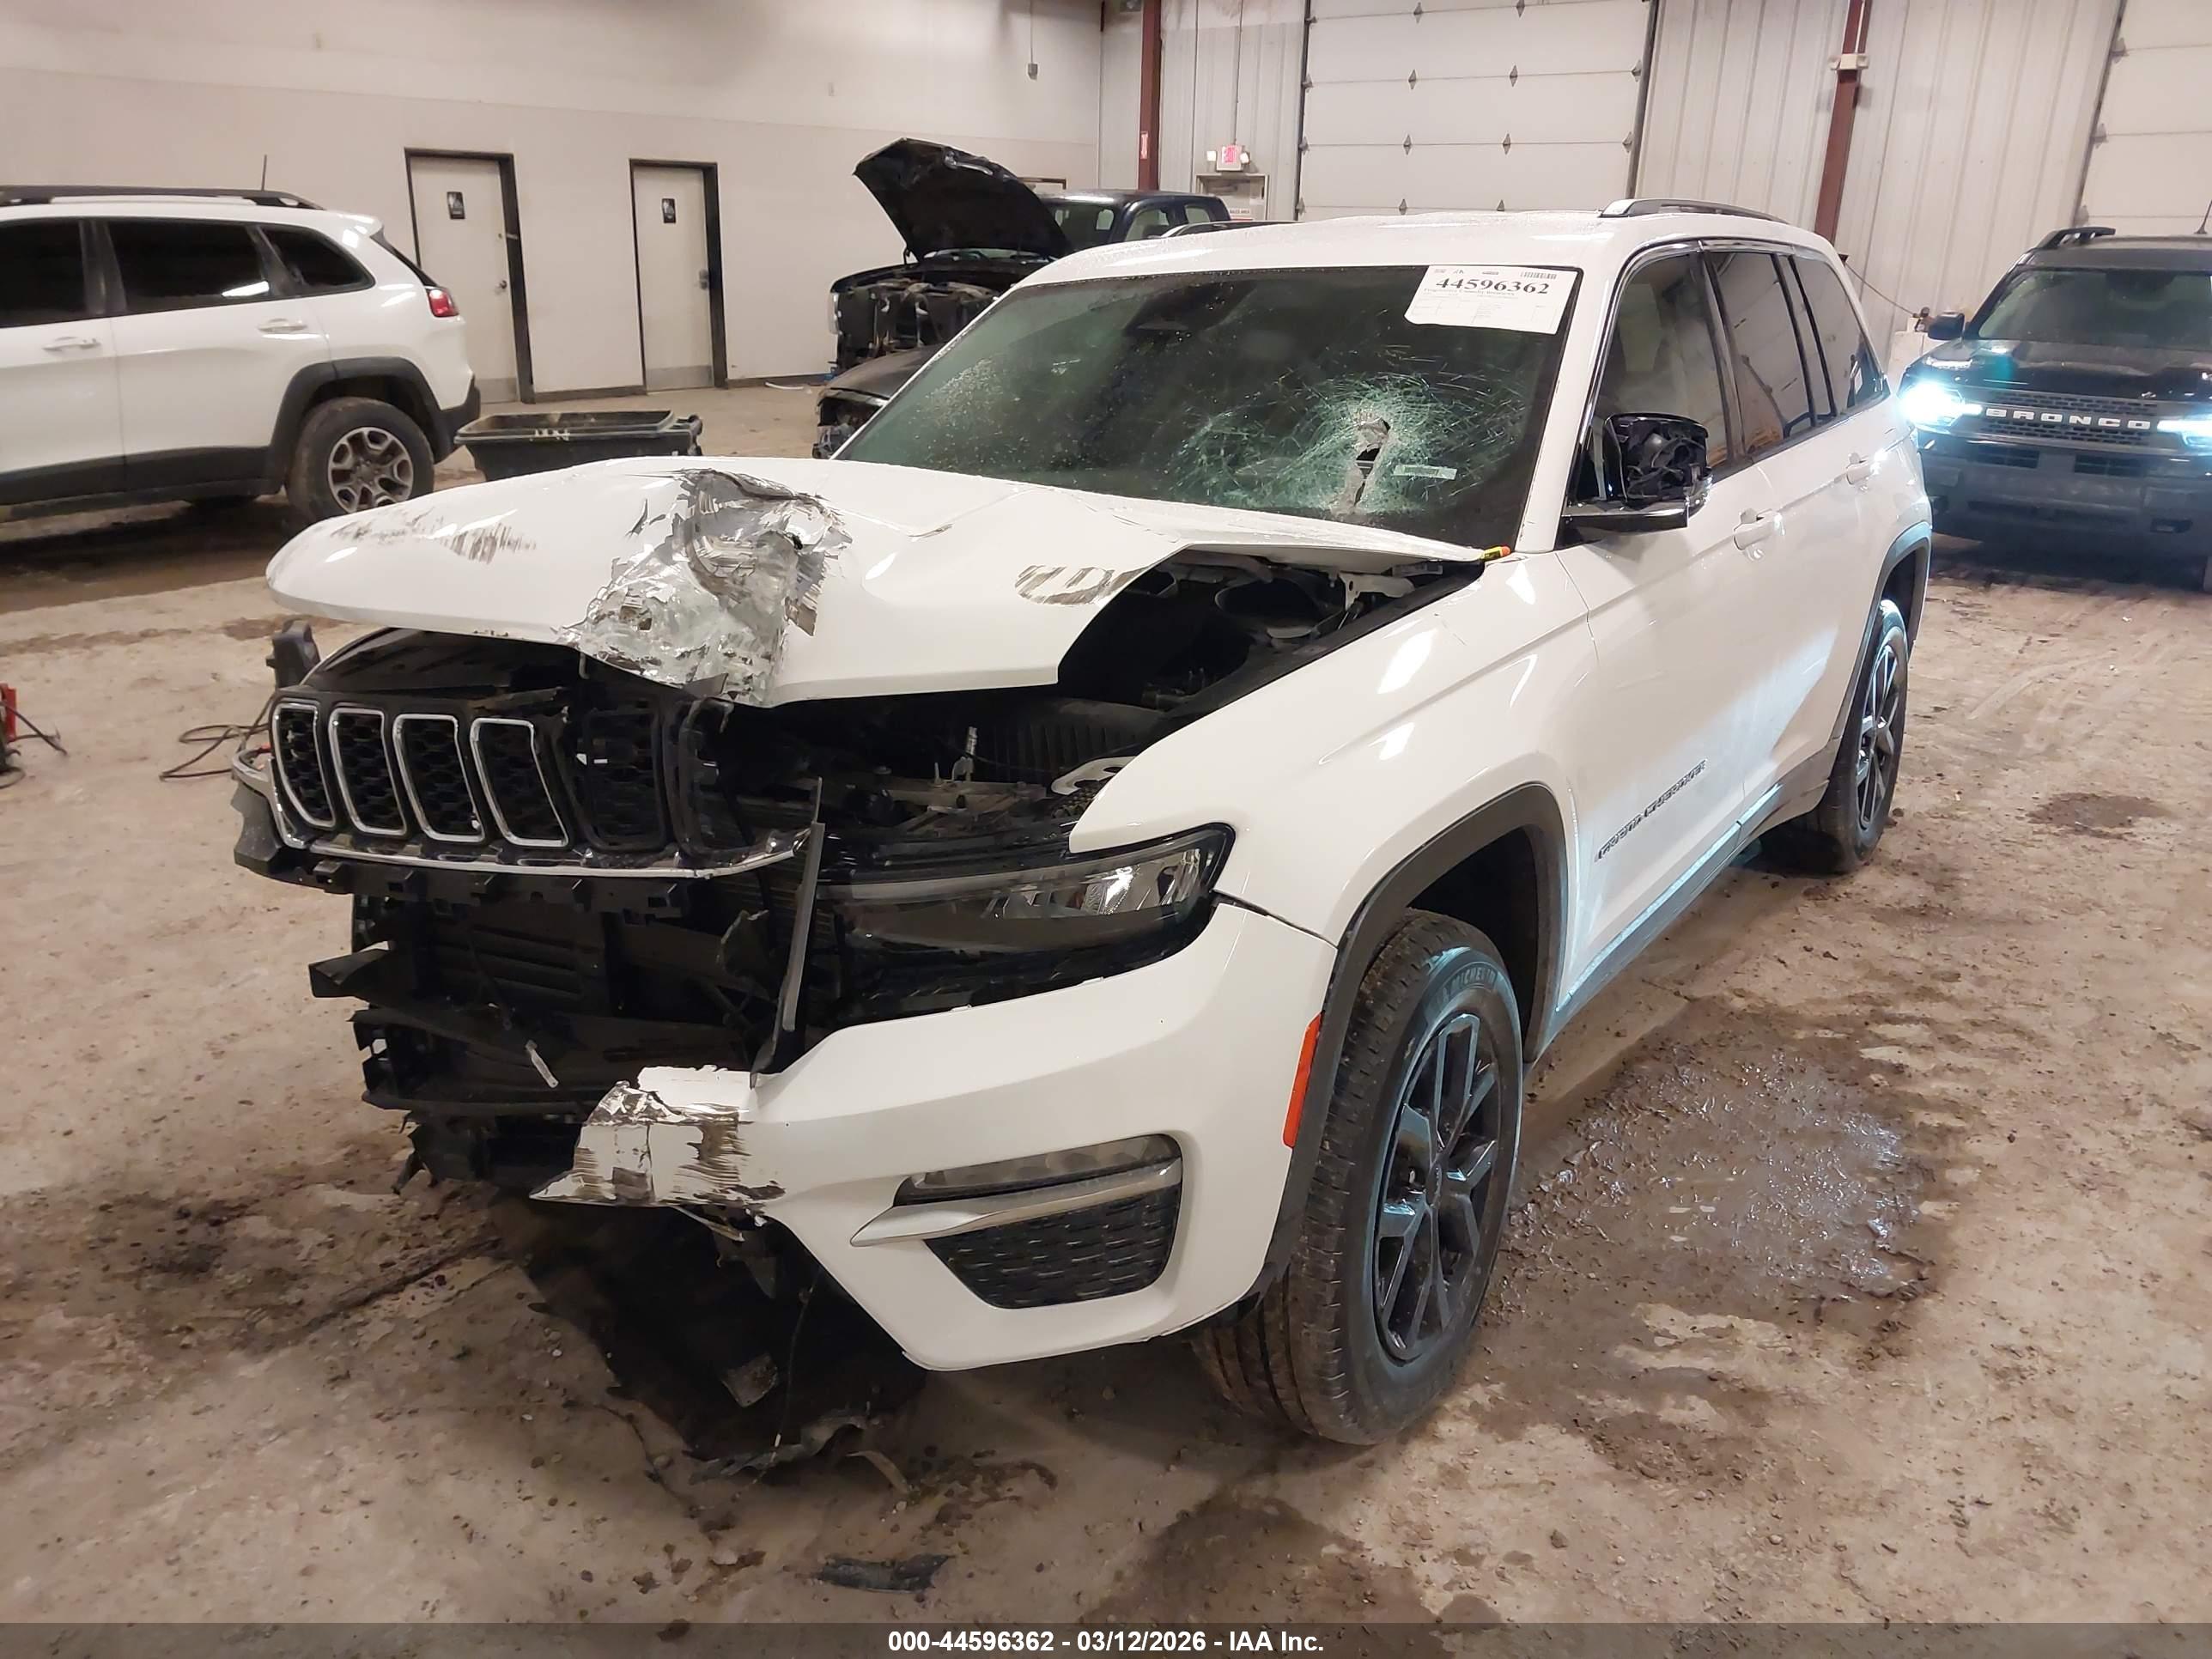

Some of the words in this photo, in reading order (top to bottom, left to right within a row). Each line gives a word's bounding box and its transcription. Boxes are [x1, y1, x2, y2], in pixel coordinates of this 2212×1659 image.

[1436, 277, 1550, 295] 44596362
[1985, 408, 2151, 429] BRONCO
[1450, 966, 1497, 990] MICHELIN
